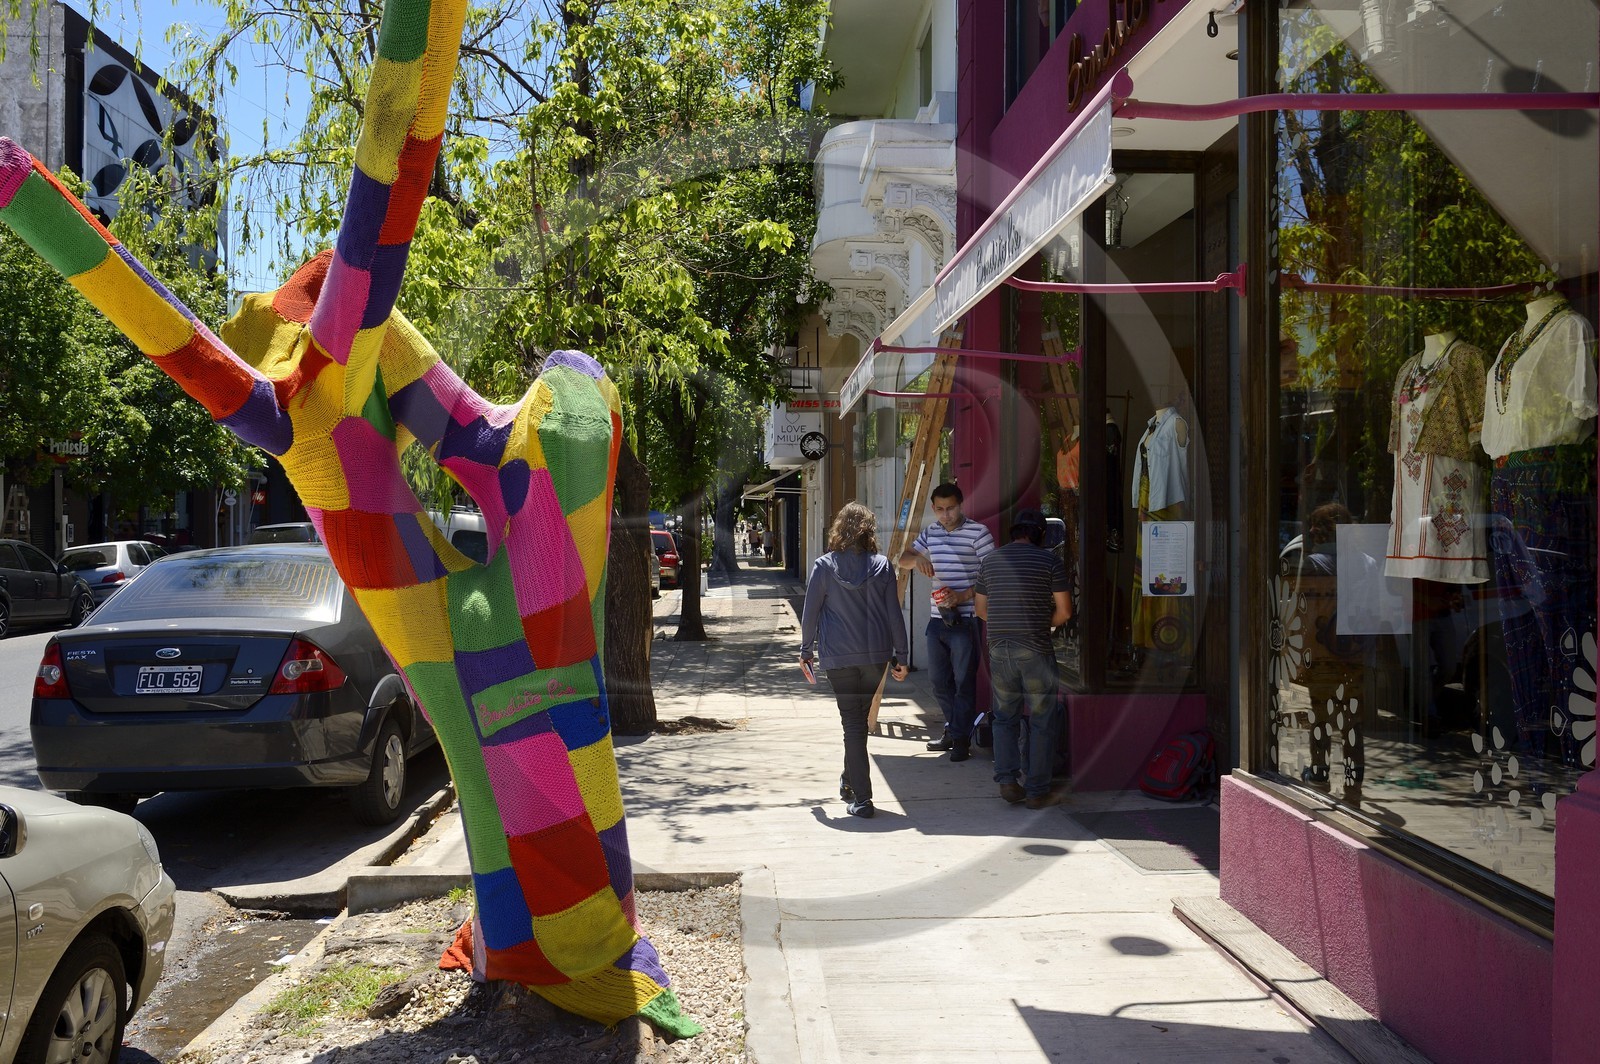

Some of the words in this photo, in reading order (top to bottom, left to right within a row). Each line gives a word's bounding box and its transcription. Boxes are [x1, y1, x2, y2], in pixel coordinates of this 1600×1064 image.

[789, 400, 820, 408] MISS
[781, 424, 807, 433] LOVE
[139, 673, 165, 688] FLQ
[173, 672, 199, 687] 562
